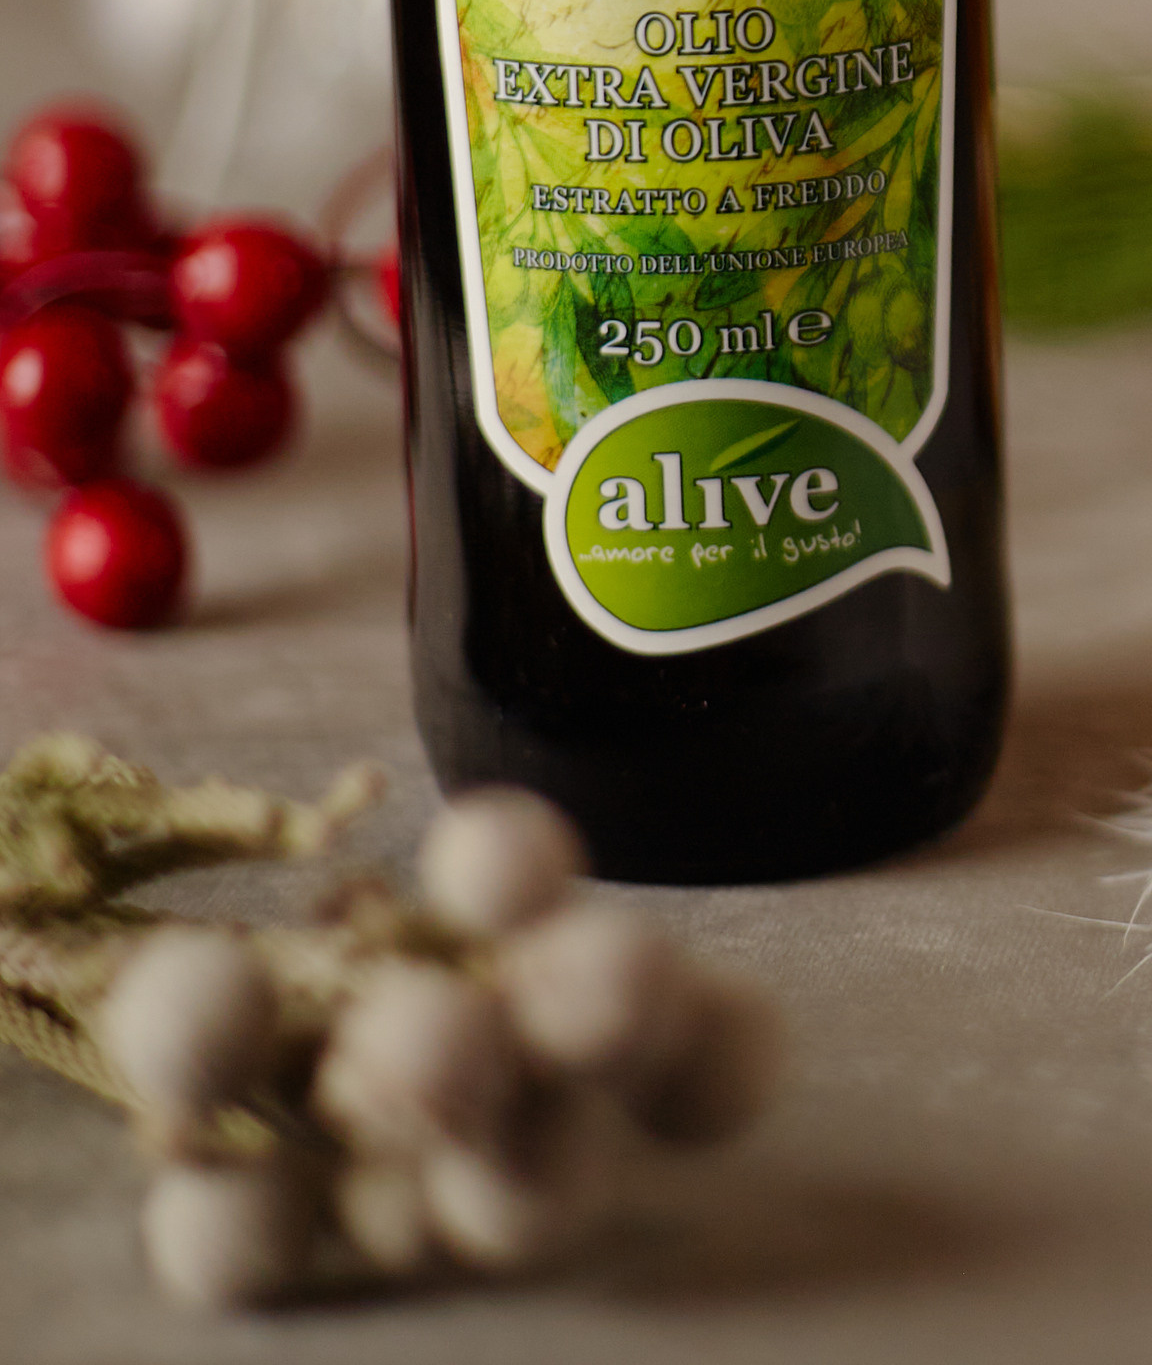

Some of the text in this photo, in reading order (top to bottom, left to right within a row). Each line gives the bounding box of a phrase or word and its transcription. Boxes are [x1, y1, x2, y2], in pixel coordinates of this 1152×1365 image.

[634, 6, 775, 57] OLIO
[493, 41, 915, 110] EXTRA VERGINE
[584, 110, 834, 163] DI OLIVA
[531, 169, 887, 216] ESTRATTO A FREDDO
[512, 230, 909, 275] PRODOTTO DELL'UNIONE EUROPEA
[599, 317, 702, 367] 250
[718, 310, 775, 356] ml
[598, 451, 840, 532] alive
[690, 541, 734, 568] per
[750, 536, 768, 560] il
[783, 519, 862, 562] gusto!
